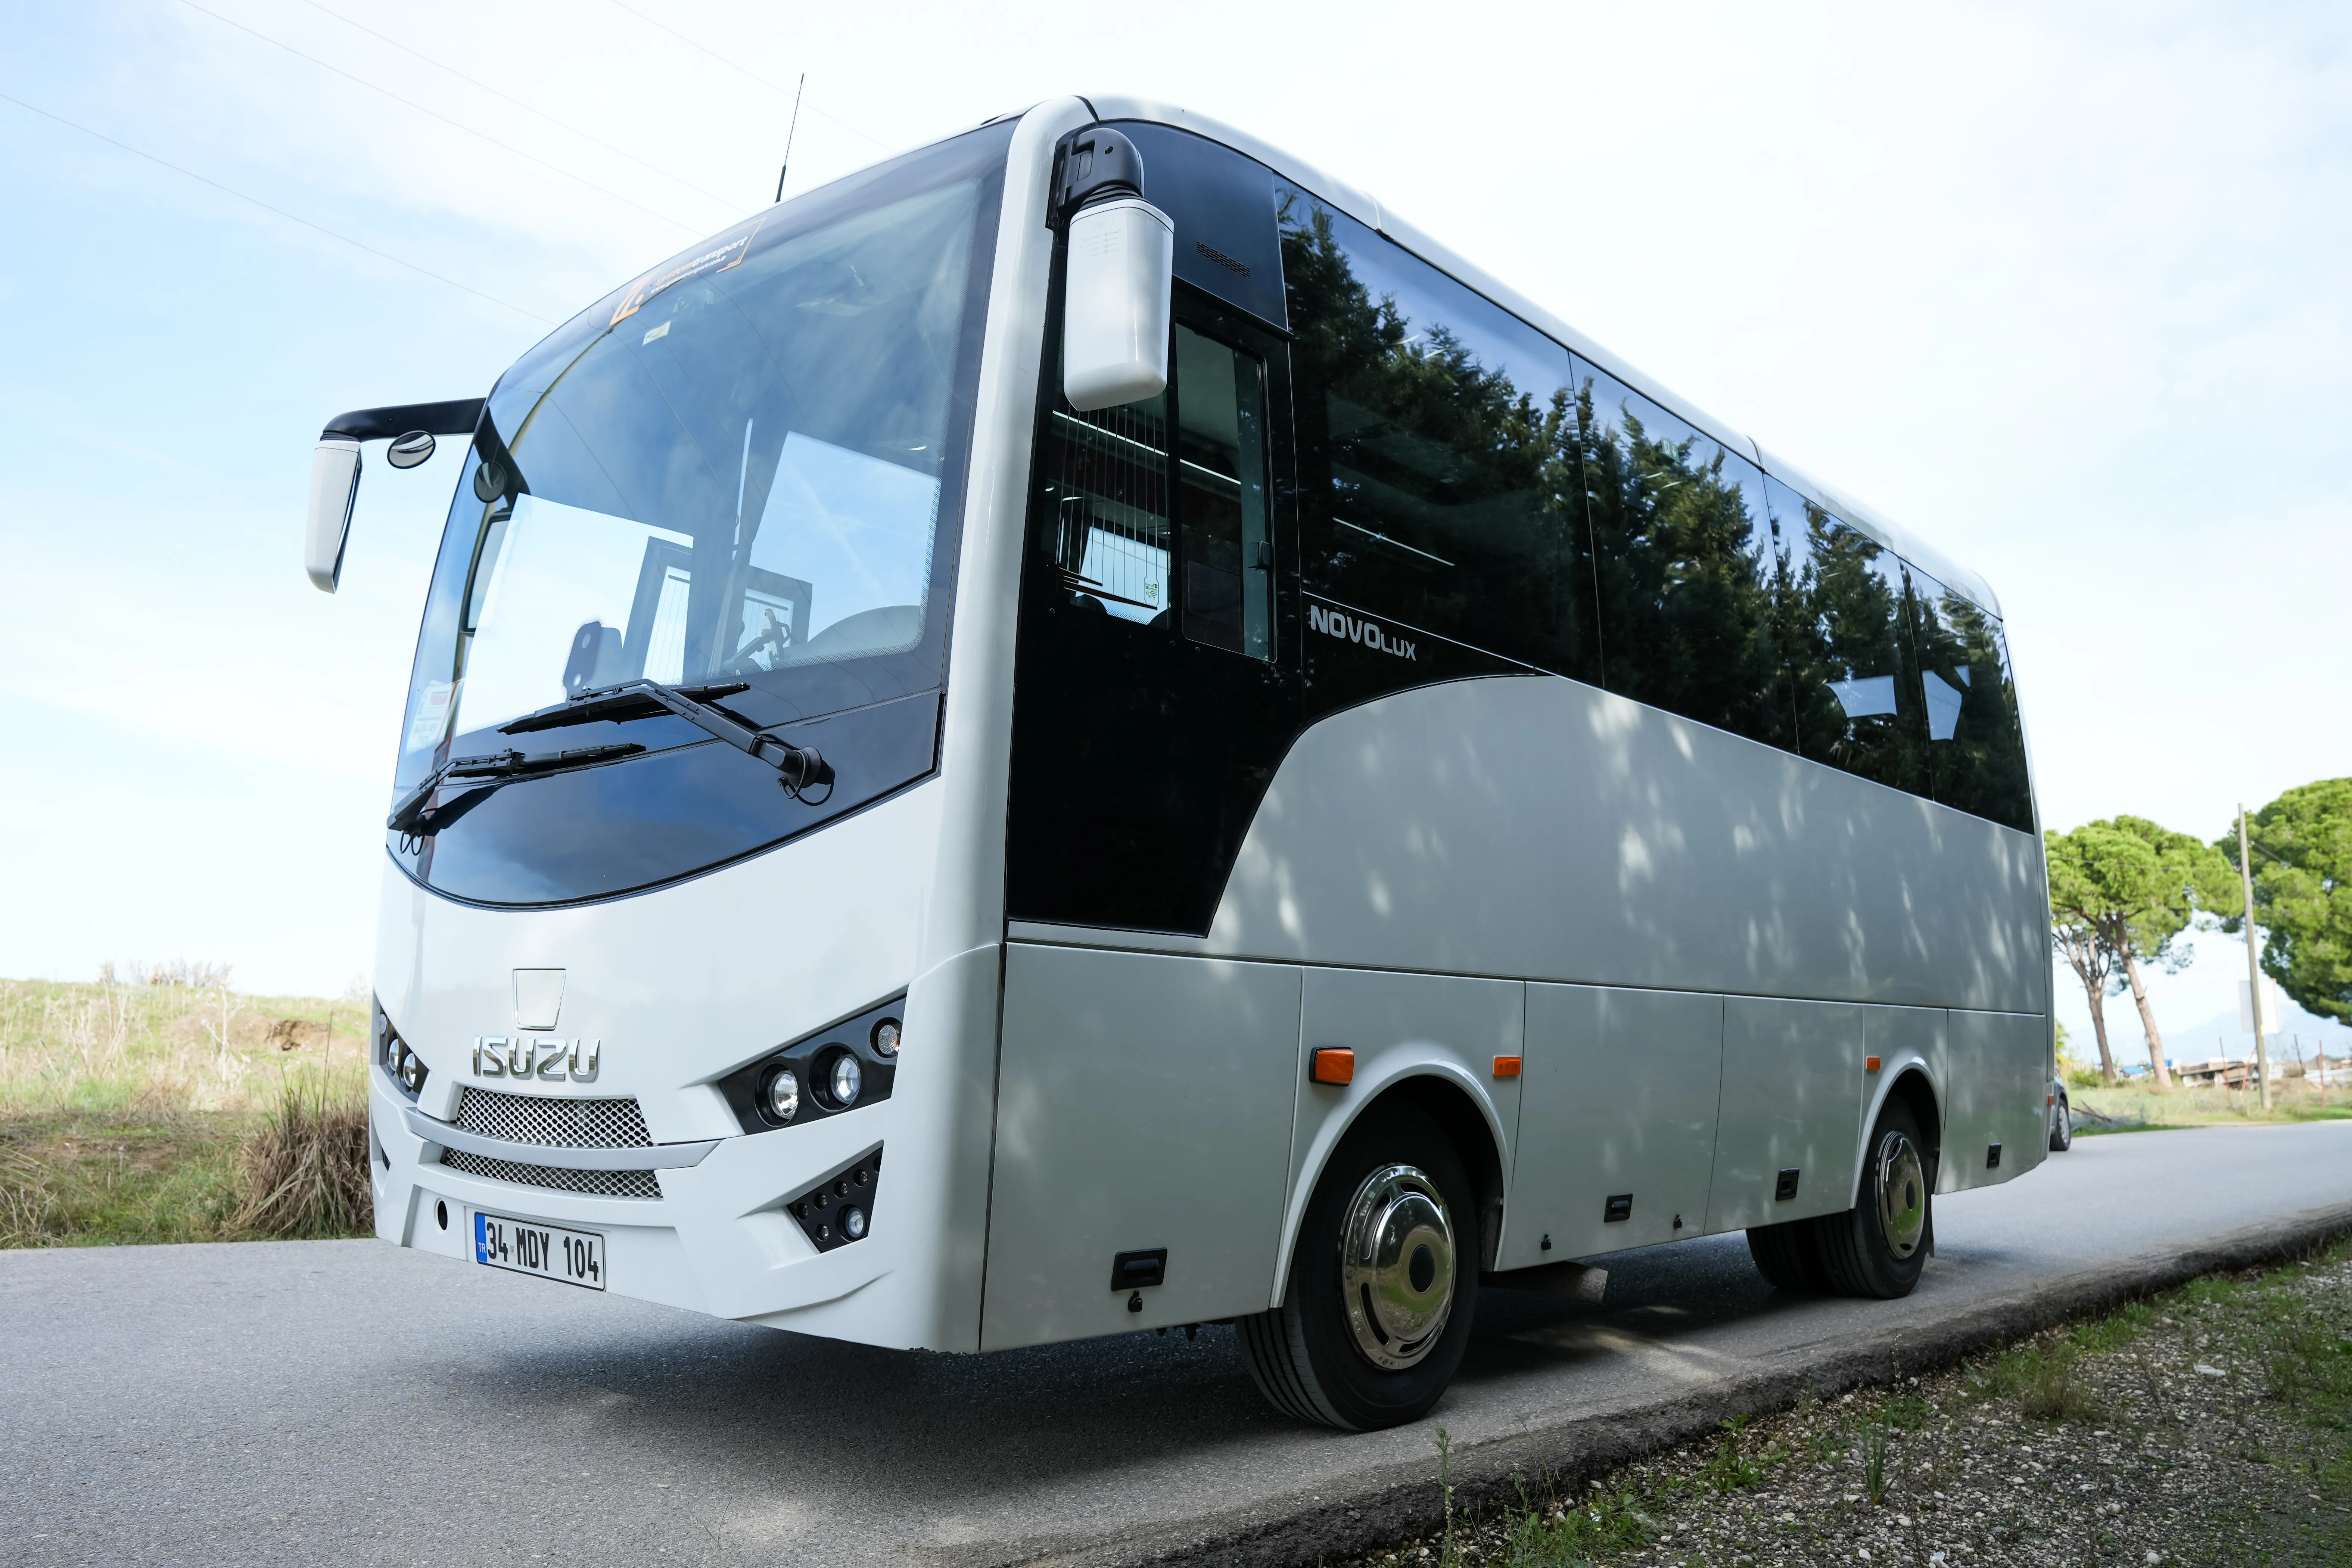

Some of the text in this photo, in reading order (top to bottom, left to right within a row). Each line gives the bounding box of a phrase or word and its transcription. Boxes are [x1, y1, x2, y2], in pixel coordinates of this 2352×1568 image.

[1310, 604, 1416, 661] NOVOLUX
[473, 1035, 600, 1083] ISUZU
[478, 1242, 486, 1254] TR
[486, 1222, 598, 1282] 34 MDY 104
